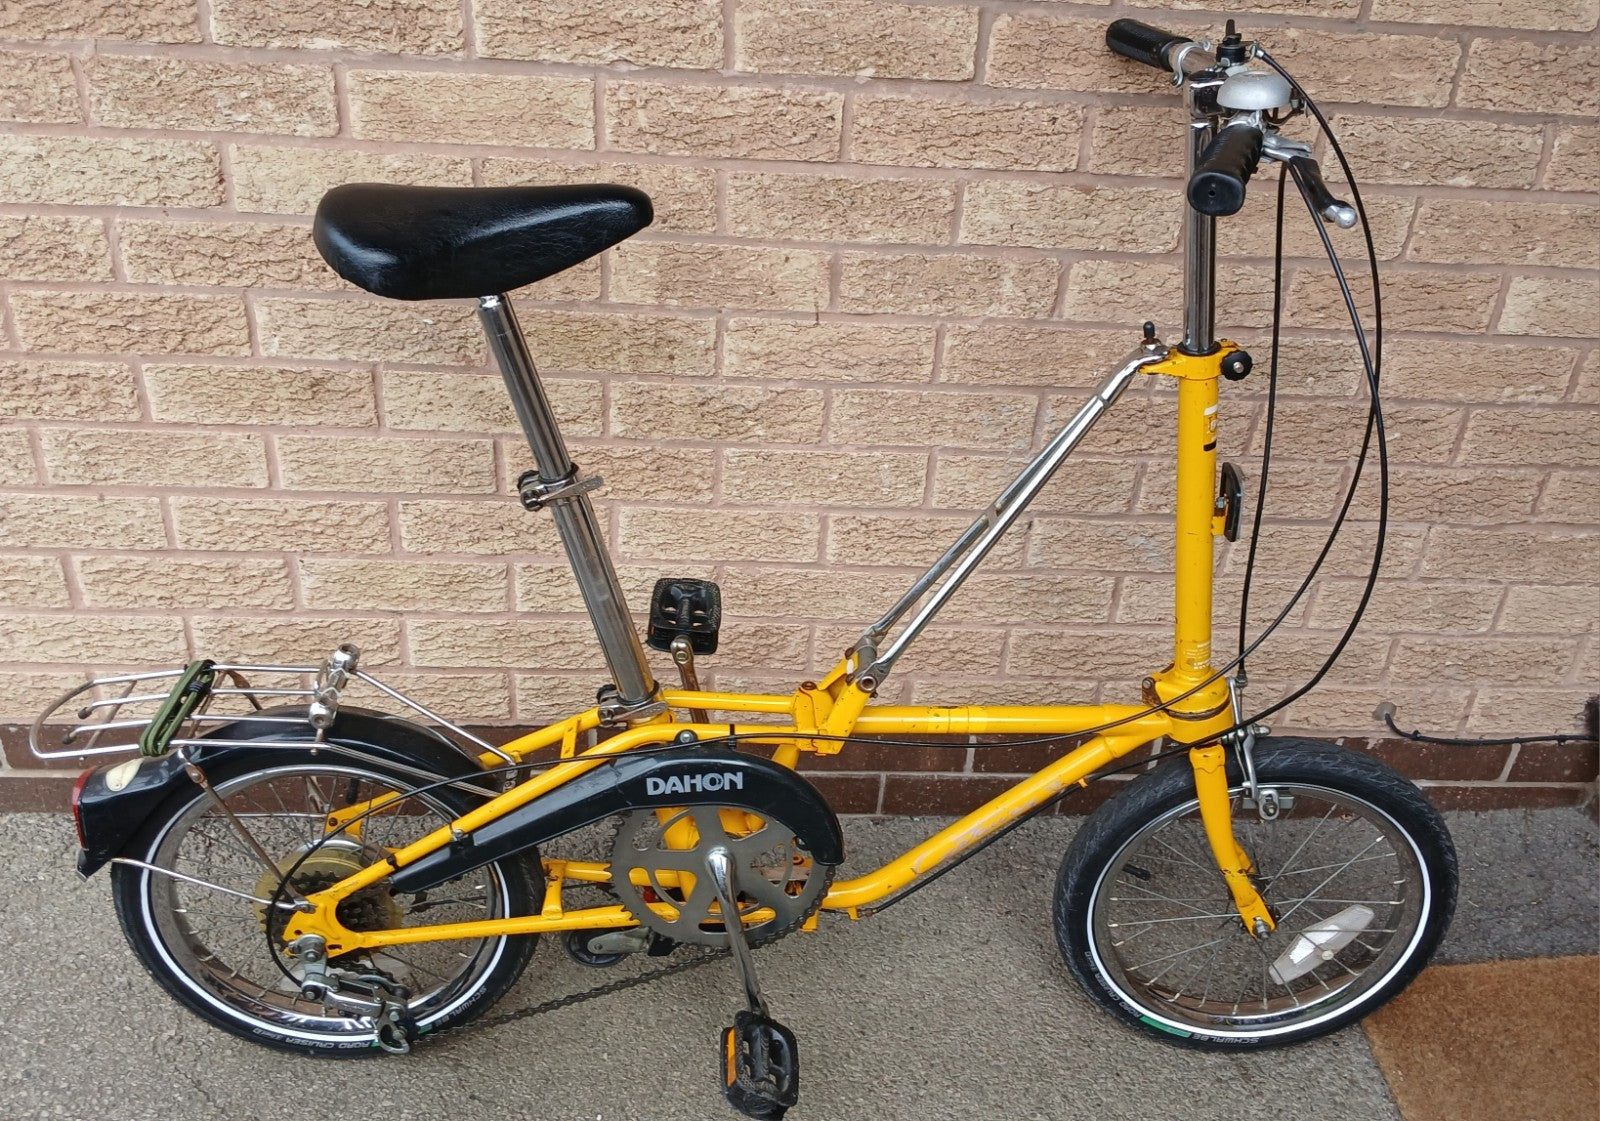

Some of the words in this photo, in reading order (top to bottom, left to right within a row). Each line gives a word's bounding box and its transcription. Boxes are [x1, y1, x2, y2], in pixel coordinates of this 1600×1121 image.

[646, 771, 744, 796] DAHON
[436, 985, 487, 1027] SCHWALBE
[1119, 1001, 1142, 1018] ROAD
[285, 1037, 335, 1049] CRUISER
[338, 1041, 370, 1049] ROAD
[1192, 1033, 1260, 1044] SCHWALBE
